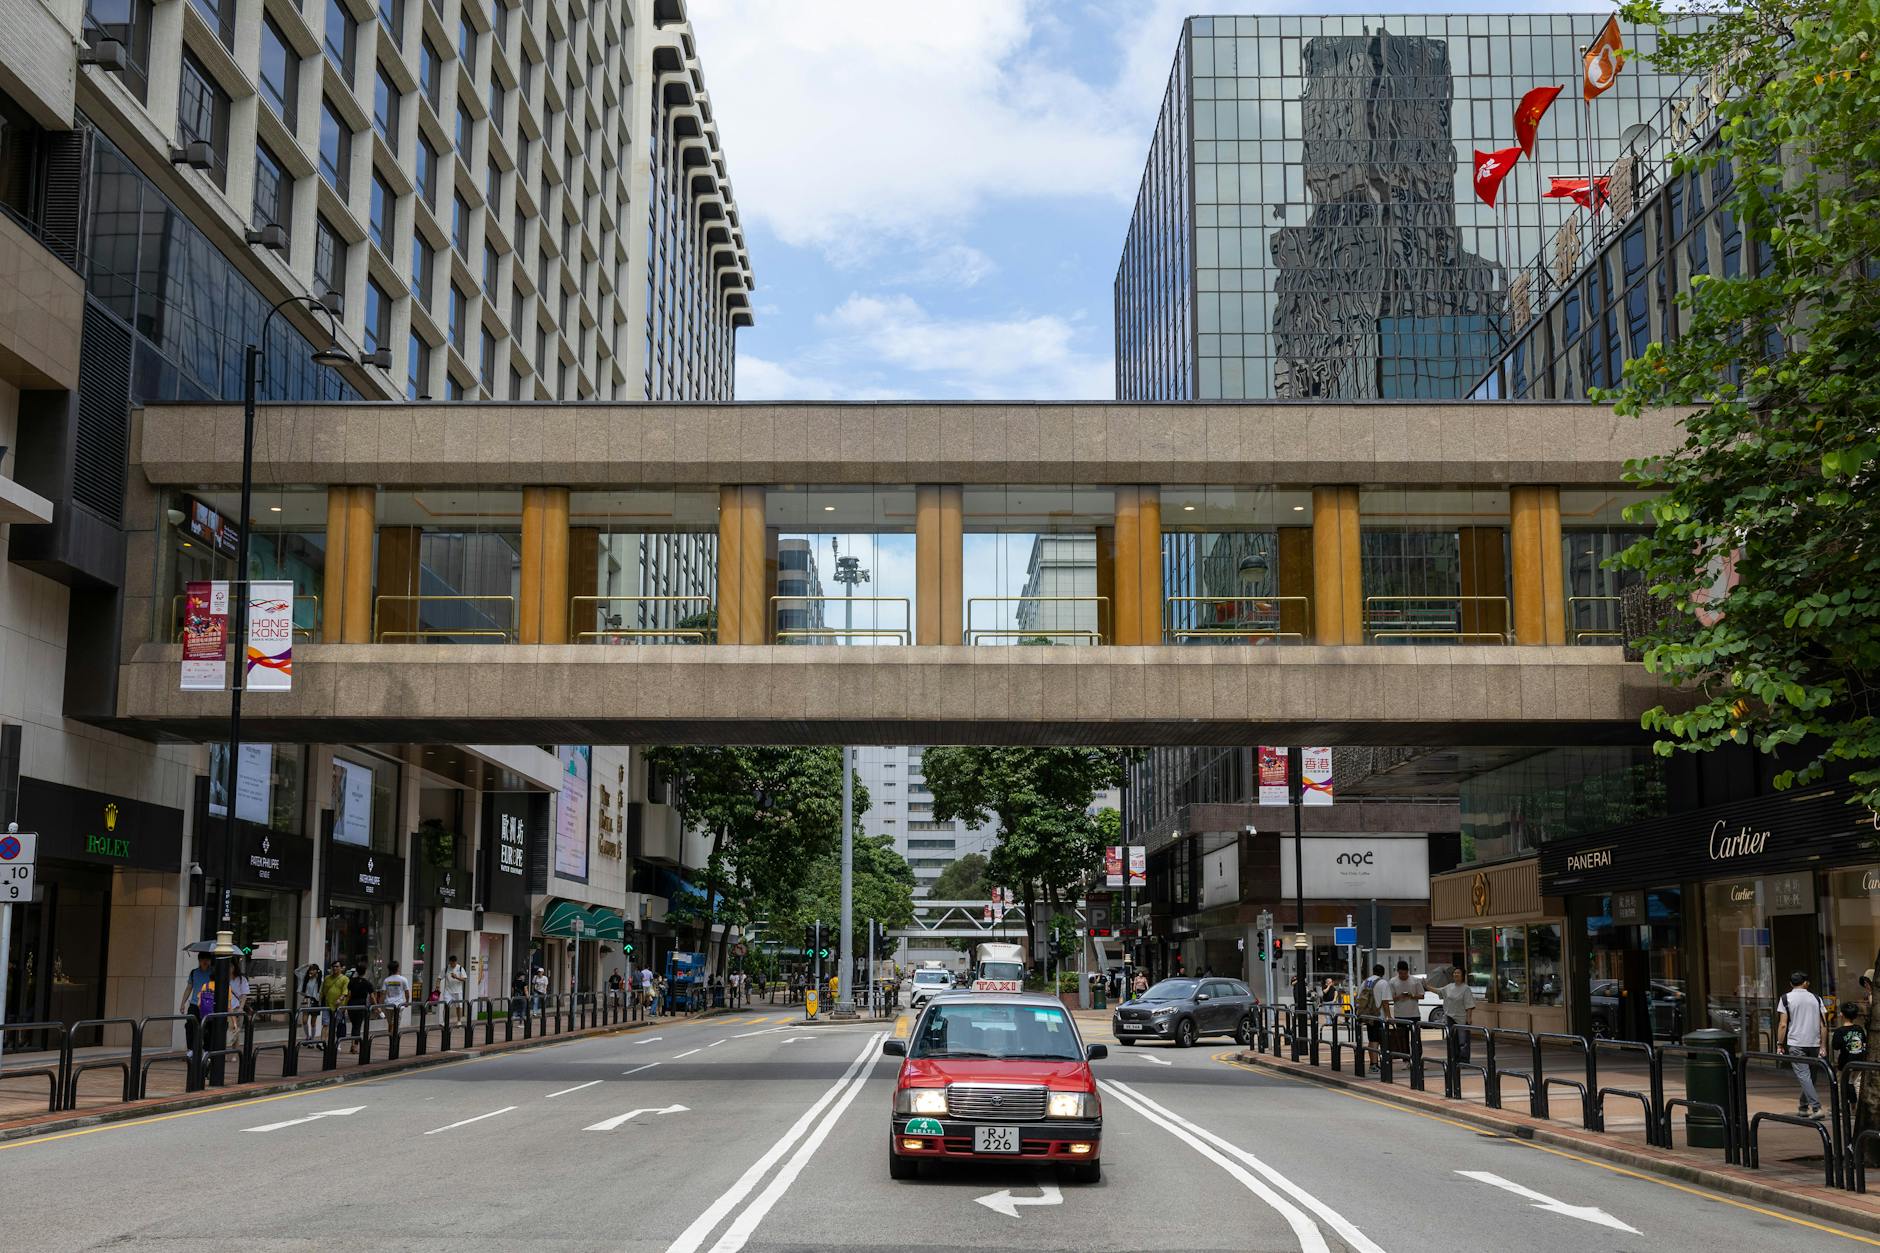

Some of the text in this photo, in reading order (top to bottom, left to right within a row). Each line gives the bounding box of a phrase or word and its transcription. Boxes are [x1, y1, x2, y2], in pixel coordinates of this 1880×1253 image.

[251, 619, 289, 628] HONG
[251, 628, 289, 637] KONG
[1304, 757, 1329, 770] 香港
[86, 833, 129, 858] ROLEX
[1709, 819, 1771, 860] Cartier
[1567, 849, 1612, 871] PANERAI
[11, 866, 28, 879] 10
[10, 886, 19, 899] 9
[976, 981, 1017, 991] TAXI
[920, 1121, 929, 1129] 4
[987, 1128, 1007, 1139] RJ
[982, 1139, 1012, 1150] 226
